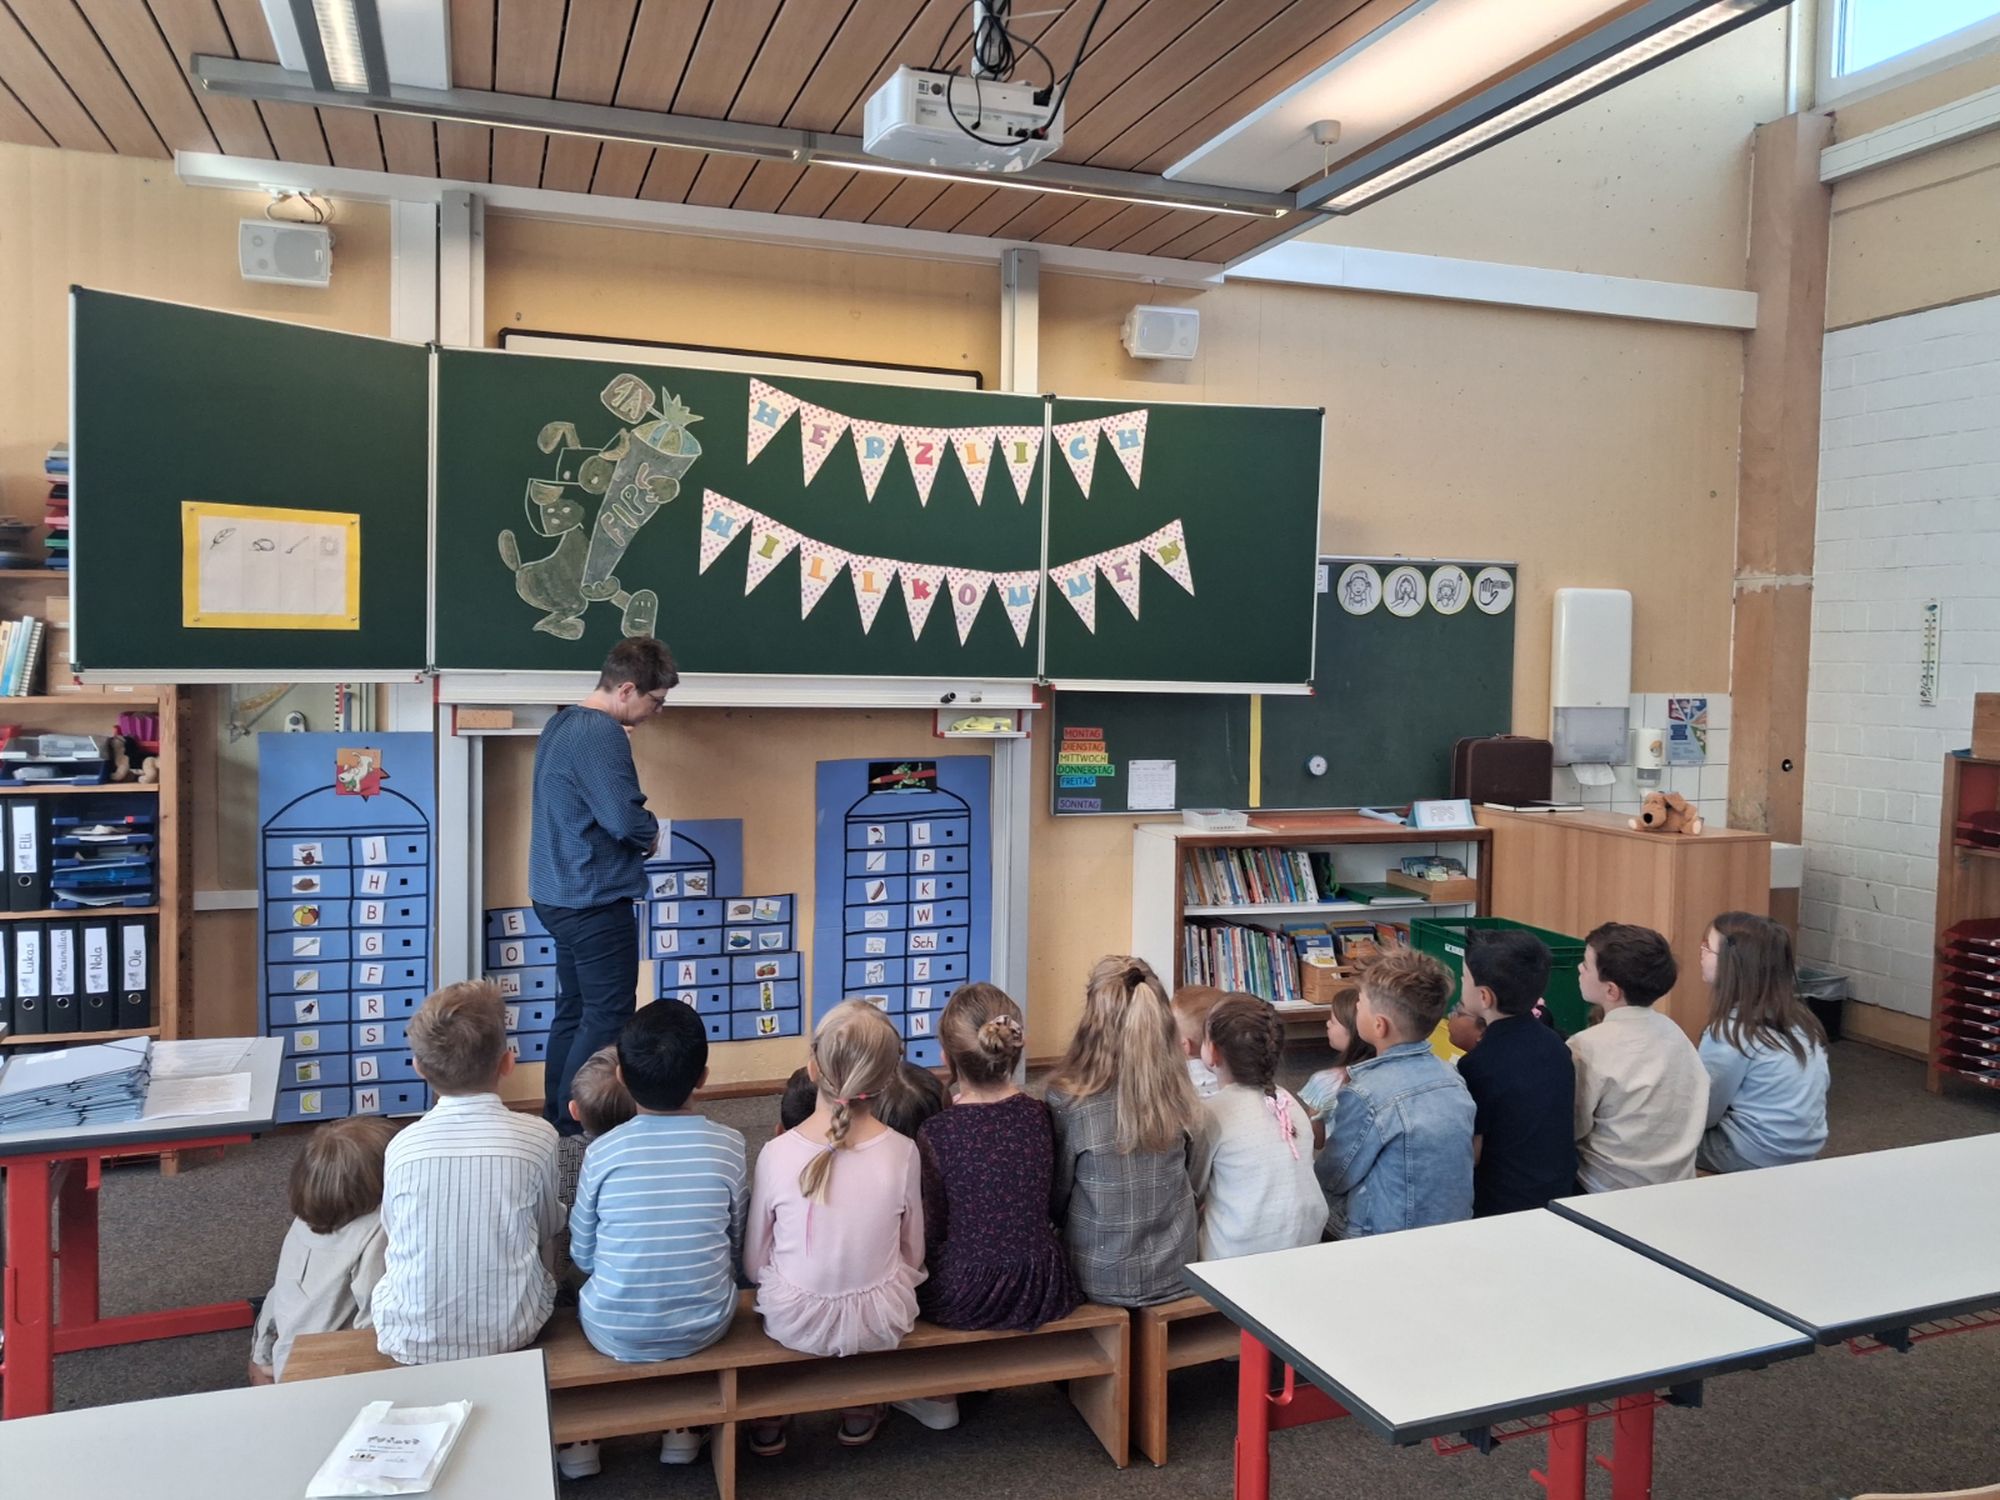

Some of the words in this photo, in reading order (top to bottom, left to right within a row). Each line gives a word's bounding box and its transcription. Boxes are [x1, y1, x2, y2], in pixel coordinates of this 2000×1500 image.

[752, 399, 1141, 468] HERZLICH
[705, 509, 1182, 609] WILLKOMMEN
[1064, 729, 1101, 738] MONTAG
[1062, 743, 1104, 752] DIENSTAG
[1060, 754, 1107, 763] MITTWOCH
[1057, 765, 1113, 774] DONNERSTAG
[1061, 777, 1094, 786] FREITAG
[1059, 799, 1099, 809] SONNTAG
[18, 832, 33, 850] Elli
[917, 827, 926, 840] L
[922, 854, 931, 867] P
[368, 875, 380, 890] H
[921, 881, 930, 896] K
[366, 905, 378, 920] B
[916, 908, 931, 922] W
[508, 915, 519, 931] E
[365, 936, 377, 952] G
[660, 934, 673, 949] U
[911, 936, 934, 949] Sch
[22, 942, 34, 975] Lukas
[56, 929, 68, 981] Maximilian
[90, 945, 103, 971] Nola
[128, 949, 142, 968] Ole
[505, 946, 518, 962] O
[367, 966, 379, 982] F
[917, 962, 927, 977] Z
[917, 991, 926, 1004] T
[368, 998, 378, 1014] R
[915, 1018, 924, 1030] N
[365, 1028, 377, 1043] S
[360, 1061, 372, 1077] D
[361, 1093, 375, 1108] M
